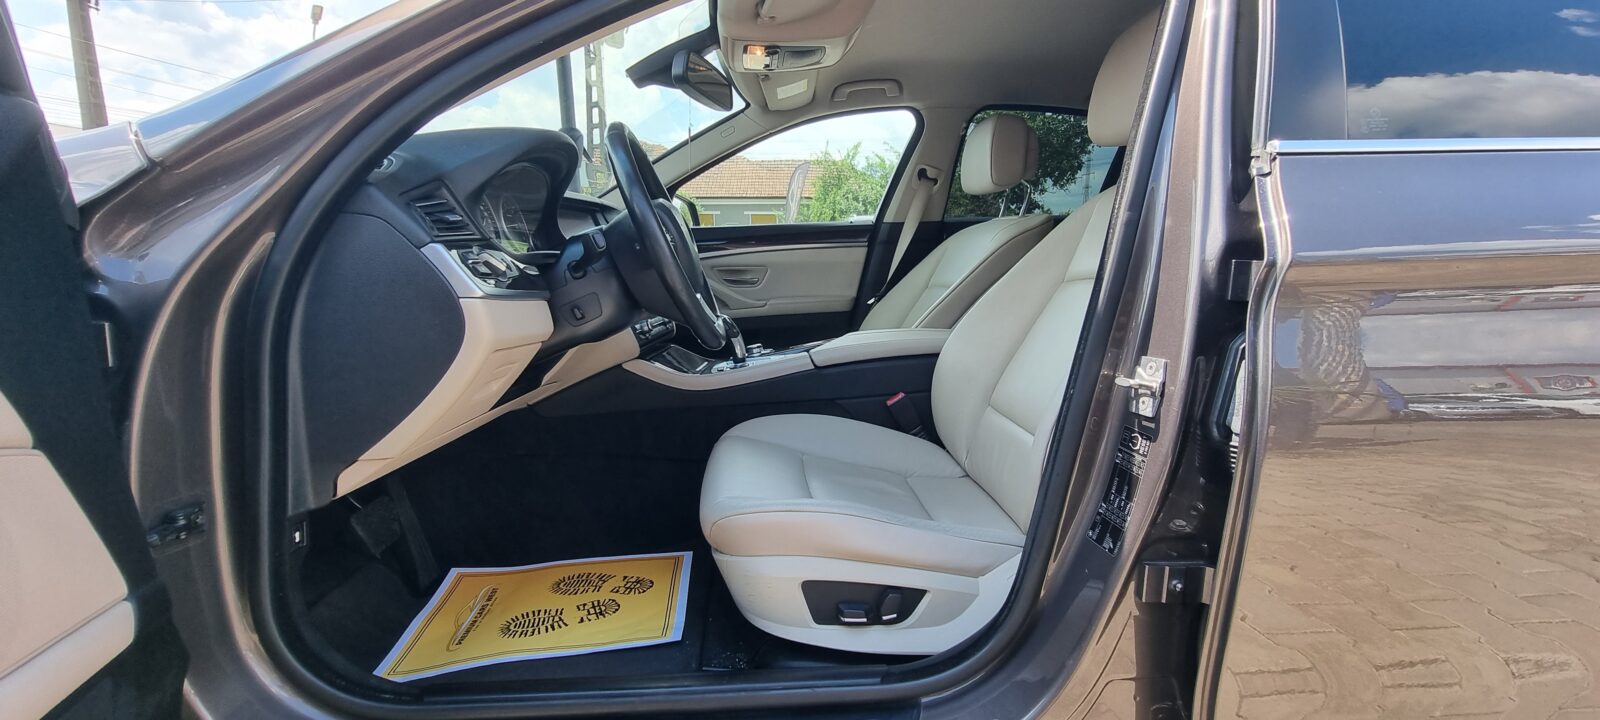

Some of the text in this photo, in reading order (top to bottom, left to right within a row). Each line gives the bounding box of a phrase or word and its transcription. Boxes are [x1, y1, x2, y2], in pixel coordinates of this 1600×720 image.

[455, 619, 478, 646] PREMIUM
[474, 603, 489, 619] CARS
[484, 587, 499, 603] WEST
